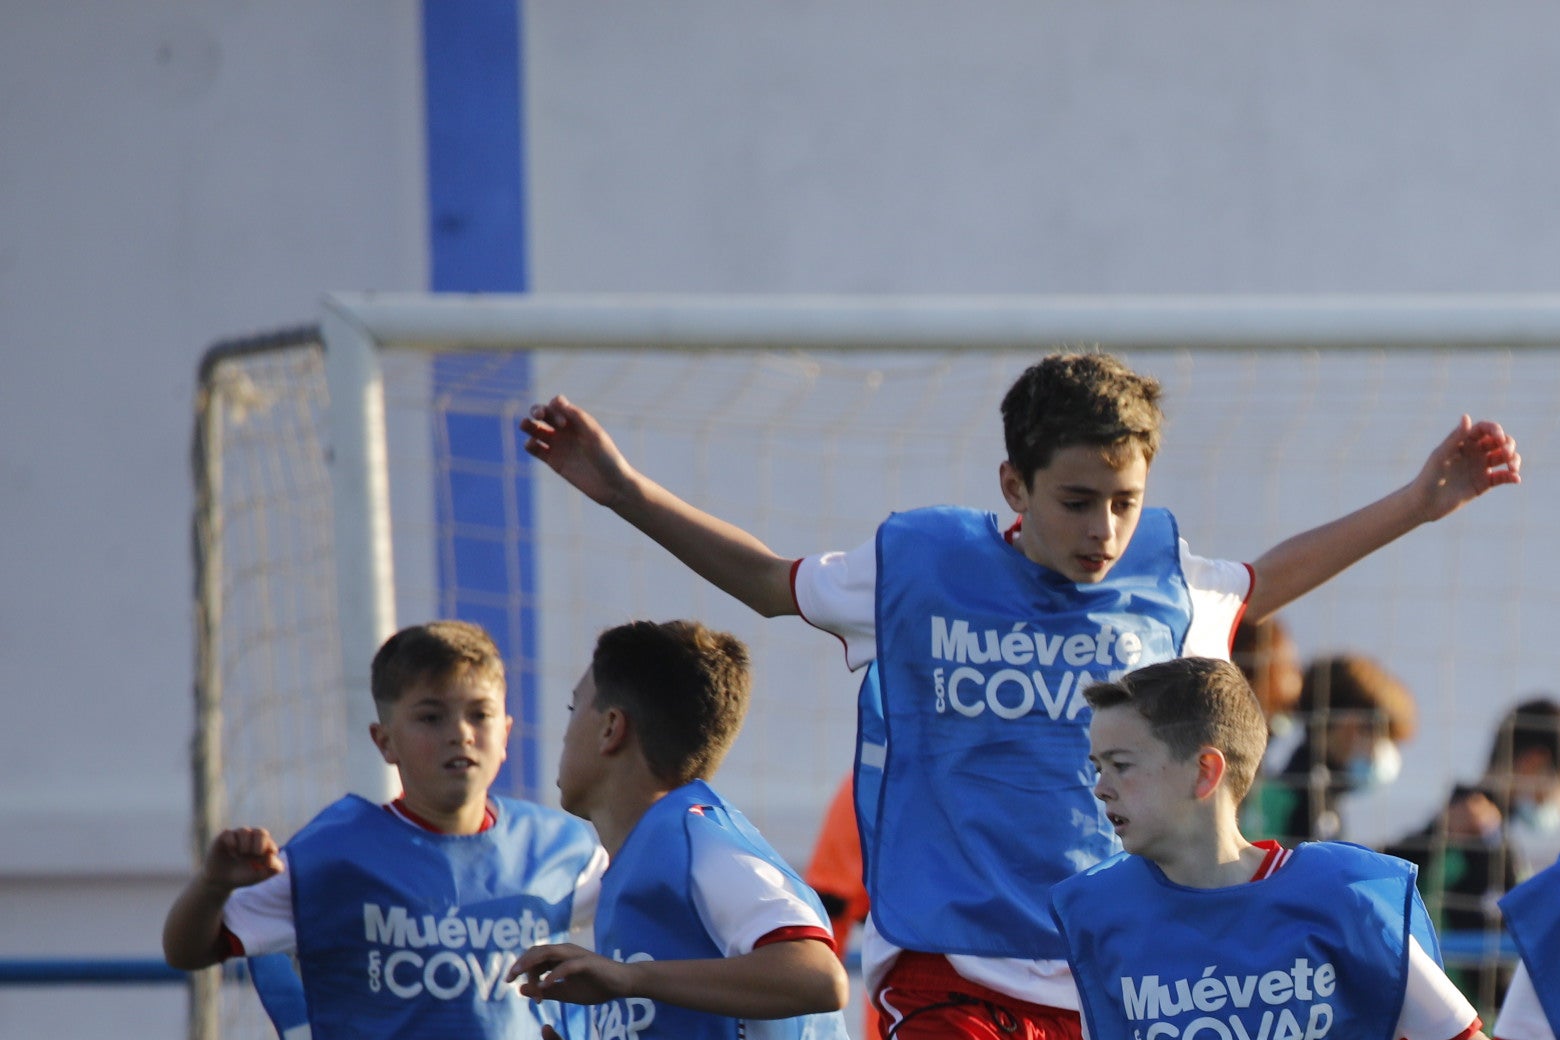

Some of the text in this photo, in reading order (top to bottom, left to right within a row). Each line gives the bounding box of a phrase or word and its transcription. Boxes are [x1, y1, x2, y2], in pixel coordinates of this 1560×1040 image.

[931, 615, 1142, 667] Muévete
[933, 666, 1123, 720] con COVA
[363, 903, 550, 950] Muévete
[367, 950, 381, 993] con
[1120, 958, 1337, 1020] Muévete
